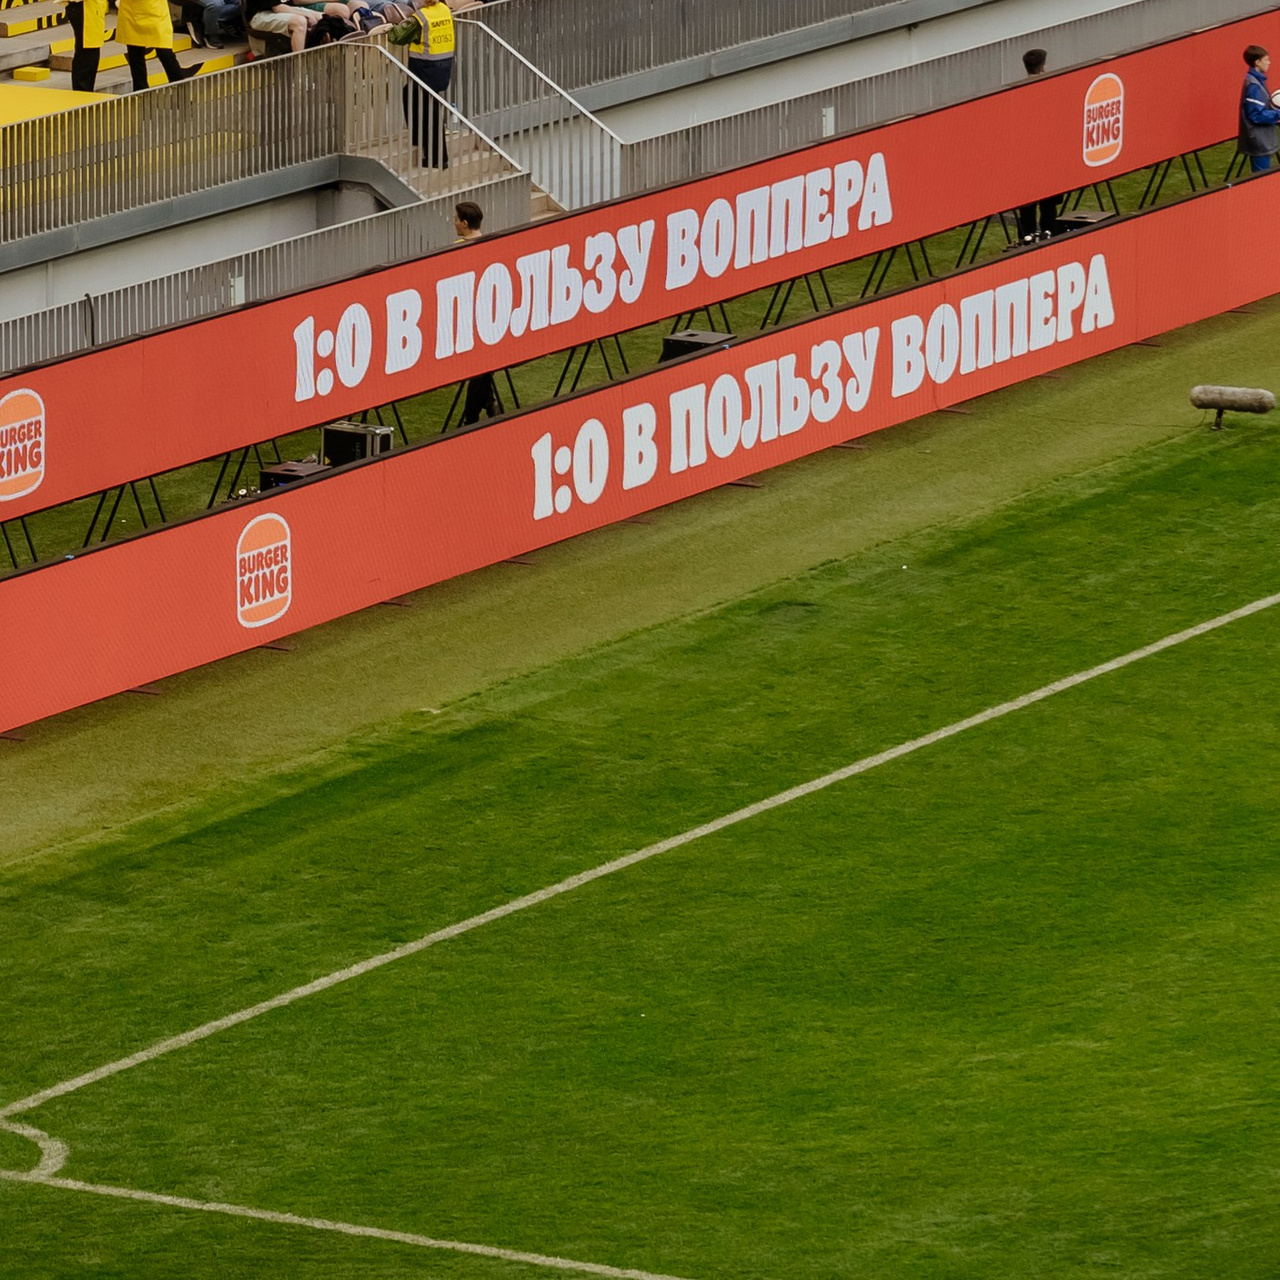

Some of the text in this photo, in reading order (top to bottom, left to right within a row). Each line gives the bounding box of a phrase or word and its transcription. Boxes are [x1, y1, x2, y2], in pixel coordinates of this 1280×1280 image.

[430, 19, 452, 28] SAFETY
[1086, 100, 1121, 124] BURGER
[1086, 117, 1120, 149] KING
[385, 289, 422, 374] В
[436, 220, 654, 359] ПОЛЬЗУ
[666, 153, 892, 290] ВОППЕРА
[623, 403, 657, 489] В
[670, 327, 879, 473] ПОЛЬЗУ
[892, 254, 1114, 397] ВОППЕРА
[239, 544, 288, 577] BURGER
[240, 565, 289, 608] KING
